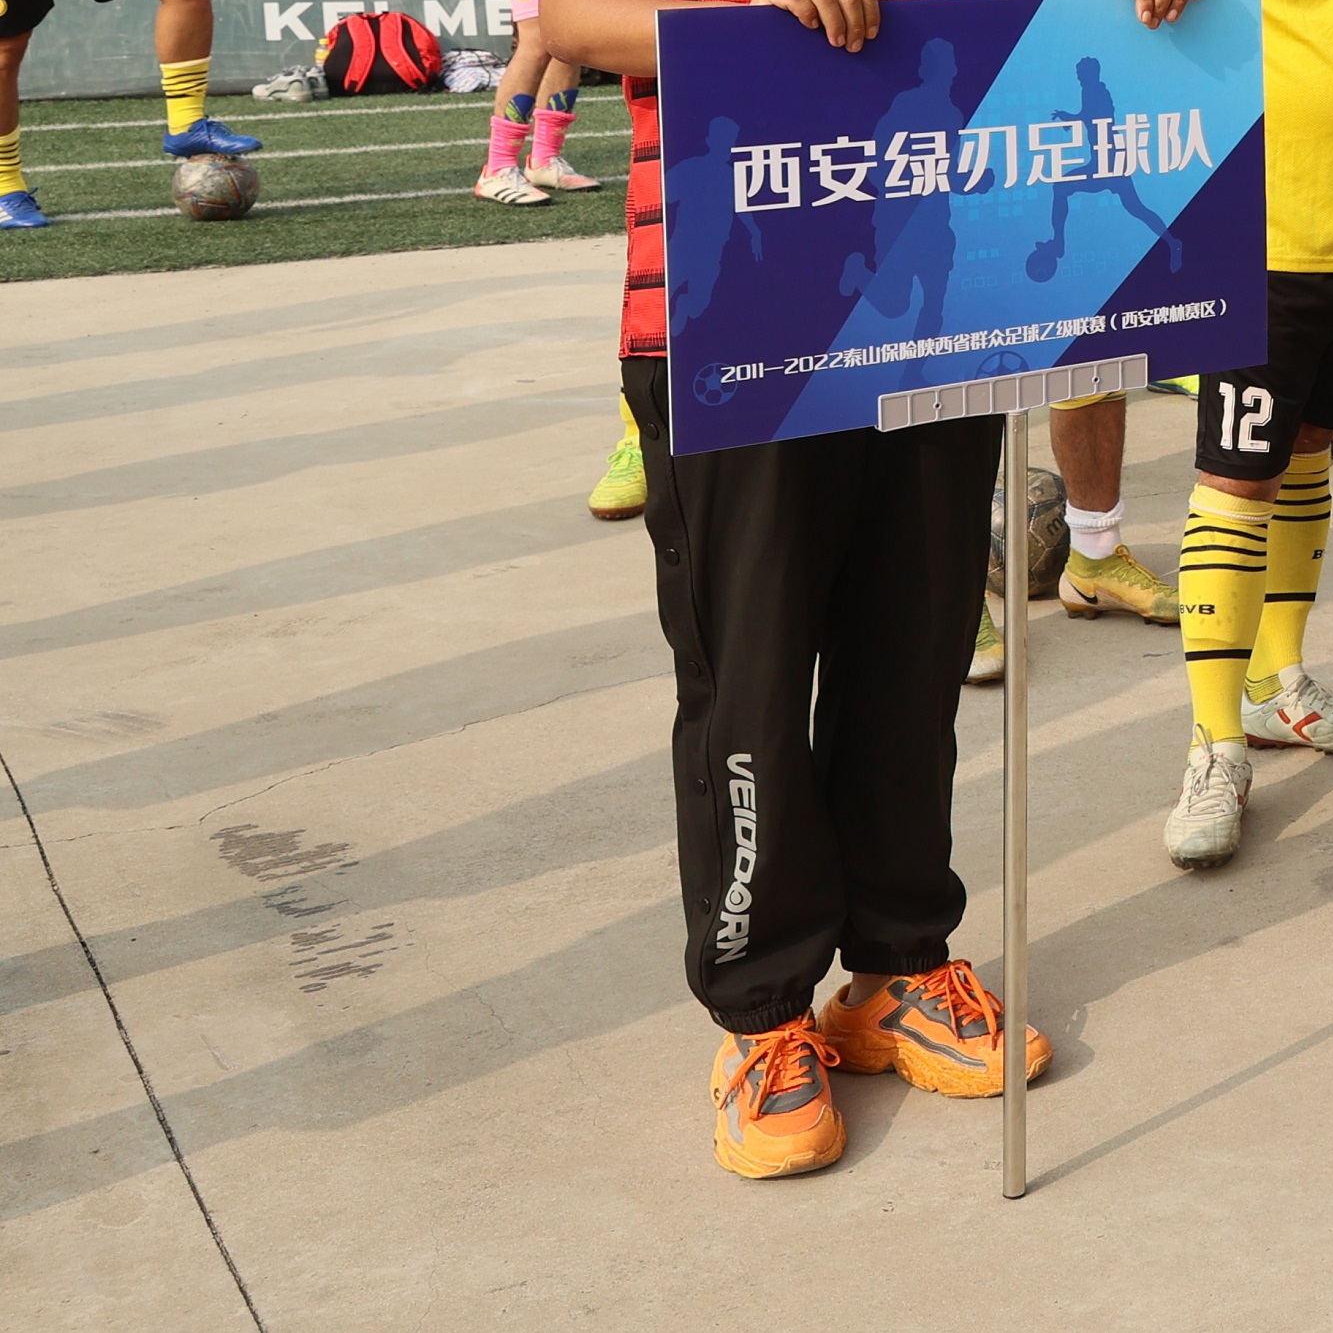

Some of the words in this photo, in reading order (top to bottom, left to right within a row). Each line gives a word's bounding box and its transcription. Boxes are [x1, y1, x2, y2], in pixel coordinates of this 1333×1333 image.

[730, 109, 1214, 214] 西安绿刃足球队
[1218, 382, 1275, 453] 12
